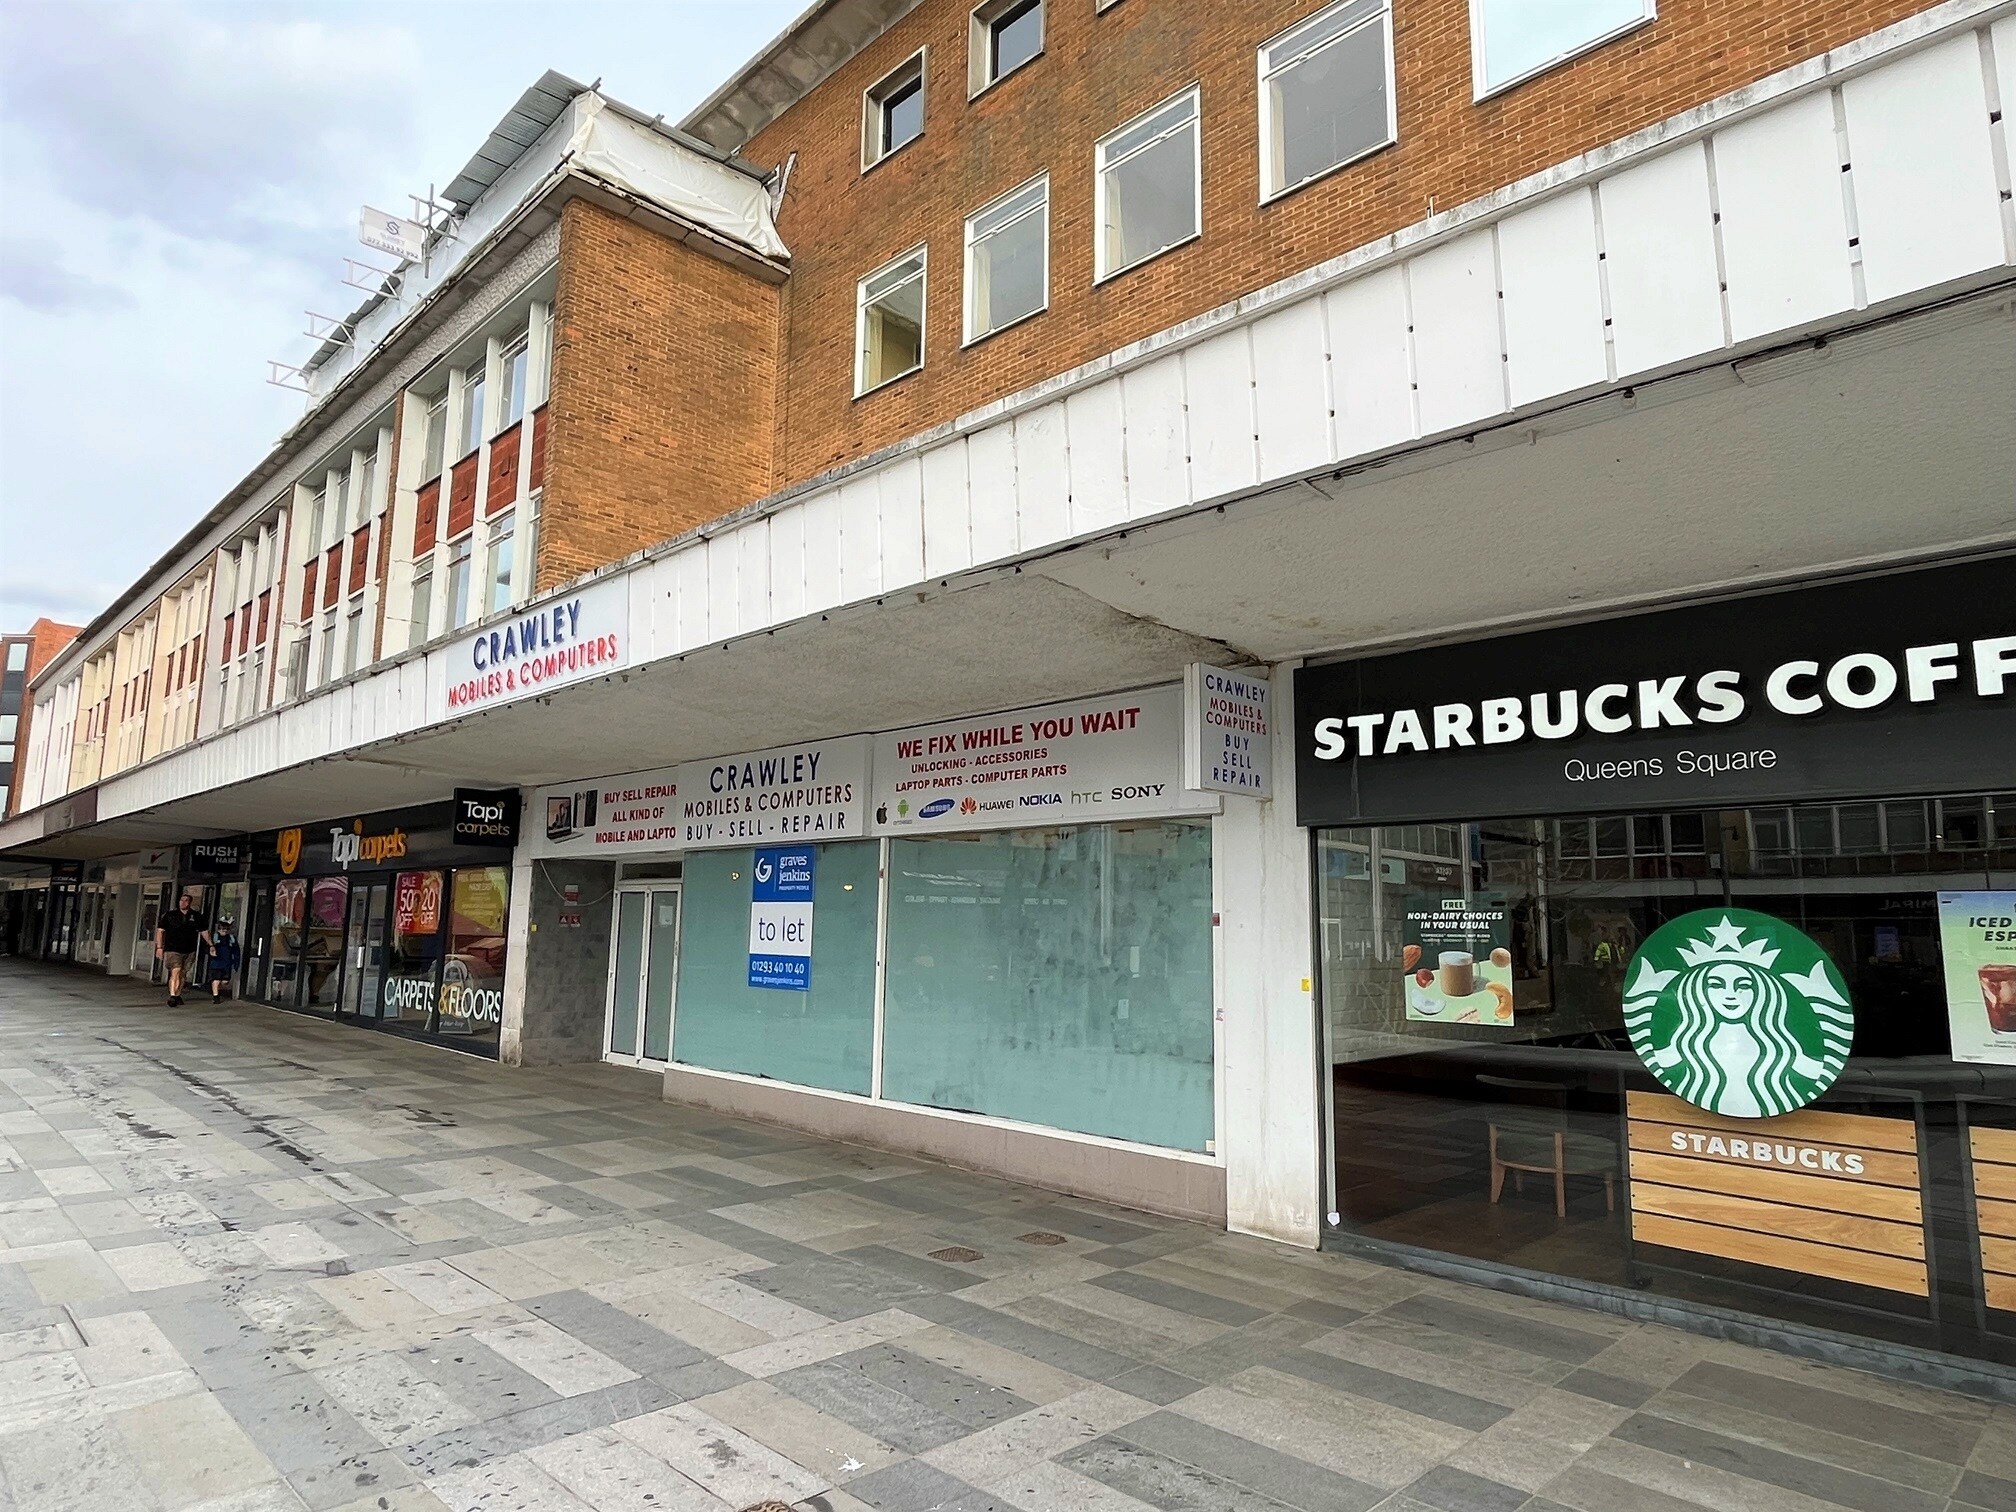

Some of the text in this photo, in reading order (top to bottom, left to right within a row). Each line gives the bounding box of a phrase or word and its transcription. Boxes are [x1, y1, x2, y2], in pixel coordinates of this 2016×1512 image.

[473, 599, 581, 670] CRAWLEY
[448, 634, 618, 708] MOBILES & COMPUTERS
[1205, 674, 1265, 702] CRAWLEY
[1210, 697, 1253, 718] MOBILES
[1313, 636, 2016, 762] STARBUCKS COFF
[897, 708, 1141, 759] WE FIX WHILE YOU WAIT
[1206, 712, 1267, 735] COMPUTERS
[1225, 734, 1249, 751] BUY
[911, 758, 967, 774] UNLOCKING
[975, 748, 1048, 768] ACCESSORIES
[1223, 751, 1251, 769] SELL
[1564, 748, 1778, 783] Queens Square
[709, 752, 821, 793] CRAWLEY
[895, 777, 930, 792] LAPTOP
[932, 774, 963, 790] PARTS
[971, 767, 1030, 786] COMPUTER
[1031, 764, 1067, 781] PARTS
[1213, 767, 1261, 788] REPAIR
[604, 785, 677, 804] BUY SELL REPAIR
[684, 784, 852, 819] MOBILES & COMPUTERS
[1019, 793, 1062, 807] NOKIA
[1111, 784, 1165, 800] SONY
[463, 801, 505, 822] Tapi
[612, 807, 665, 822] ALL KIND OF
[979, 800, 1014, 812] HUAWEI
[456, 822, 510, 836] carpets
[595, 827, 676, 843] MOBILE AND LAPTO
[686, 824, 712, 841] BUY
[729, 819, 763, 838] SELL
[781, 812, 846, 834] REPAIR
[195, 845, 237, 857] RUSH
[330, 819, 408, 870] Tapi carpets
[779, 855, 808, 868] graves
[402, 877, 416, 887] SALE
[779, 869, 811, 884] jenkins
[400, 889, 414, 911] 50
[422, 888, 436, 911] 20
[1444, 901, 1464, 909] FREE
[1407, 912, 1503, 920] NON-DAIRY CHOICES
[1420, 921, 1490, 929] IN YOUR USUAL
[1969, 917, 2012, 928] ICED
[759, 916, 805, 942] to let
[751, 960, 805, 975] 01293 40 10 40
[384, 977, 435, 1012] CARPETS
[449, 986, 502, 1023] FLOORS
[1670, 1131, 1865, 1175] STARBUCKS
